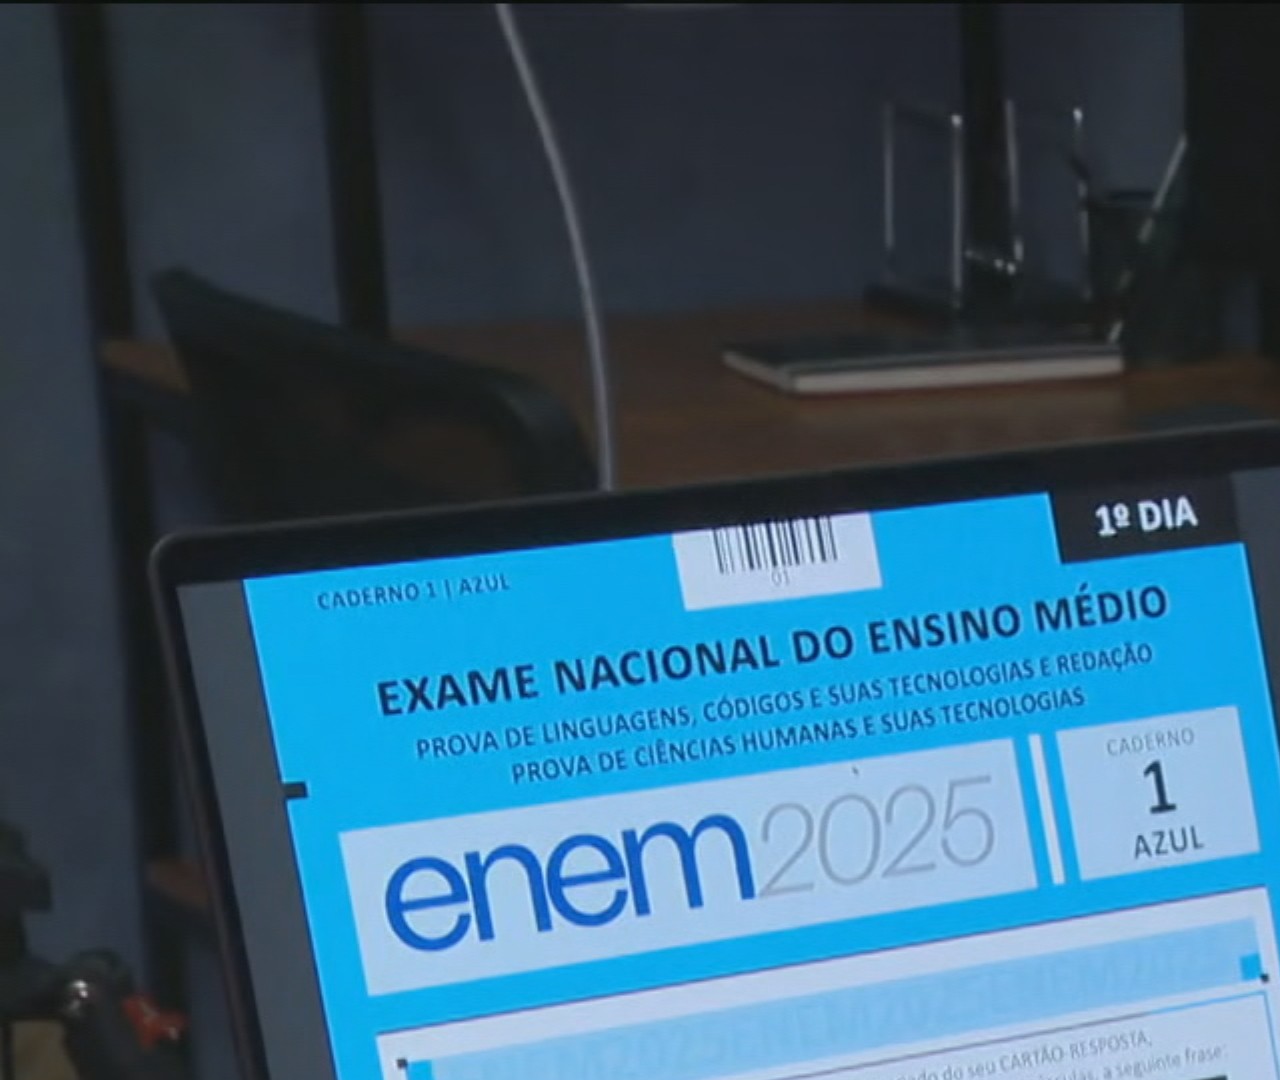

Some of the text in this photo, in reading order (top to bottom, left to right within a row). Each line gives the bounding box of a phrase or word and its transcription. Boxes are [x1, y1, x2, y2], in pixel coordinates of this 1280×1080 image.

[1138, 496, 1198, 532] DIA
[317, 582, 419, 610] CADERNO
[427, 582, 437, 598] 1
[459, 573, 511, 596] AZUL
[376, 583, 1167, 716] EXAME NACIONAL DO ENSINO MÉDIO
[417, 642, 1152, 760] PROVA DE LINGUAGENS, CÓDIGOS E SUAS TECNOLOGIAS E REDAÇÃO
[512, 687, 1085, 785] PROVA DE CIÊNCIAS HUMANAS E SUAS TECNOLOGIAS
[1107, 727, 1195, 756] CADERNO
[1143, 760, 1176, 815] 1
[1134, 825, 1204, 859] AZUL
[967, 1062, 997, 1079] seu
[1103, 1067, 1113, 1080] a
[1117, 1053, 1181, 1079] seguinte
